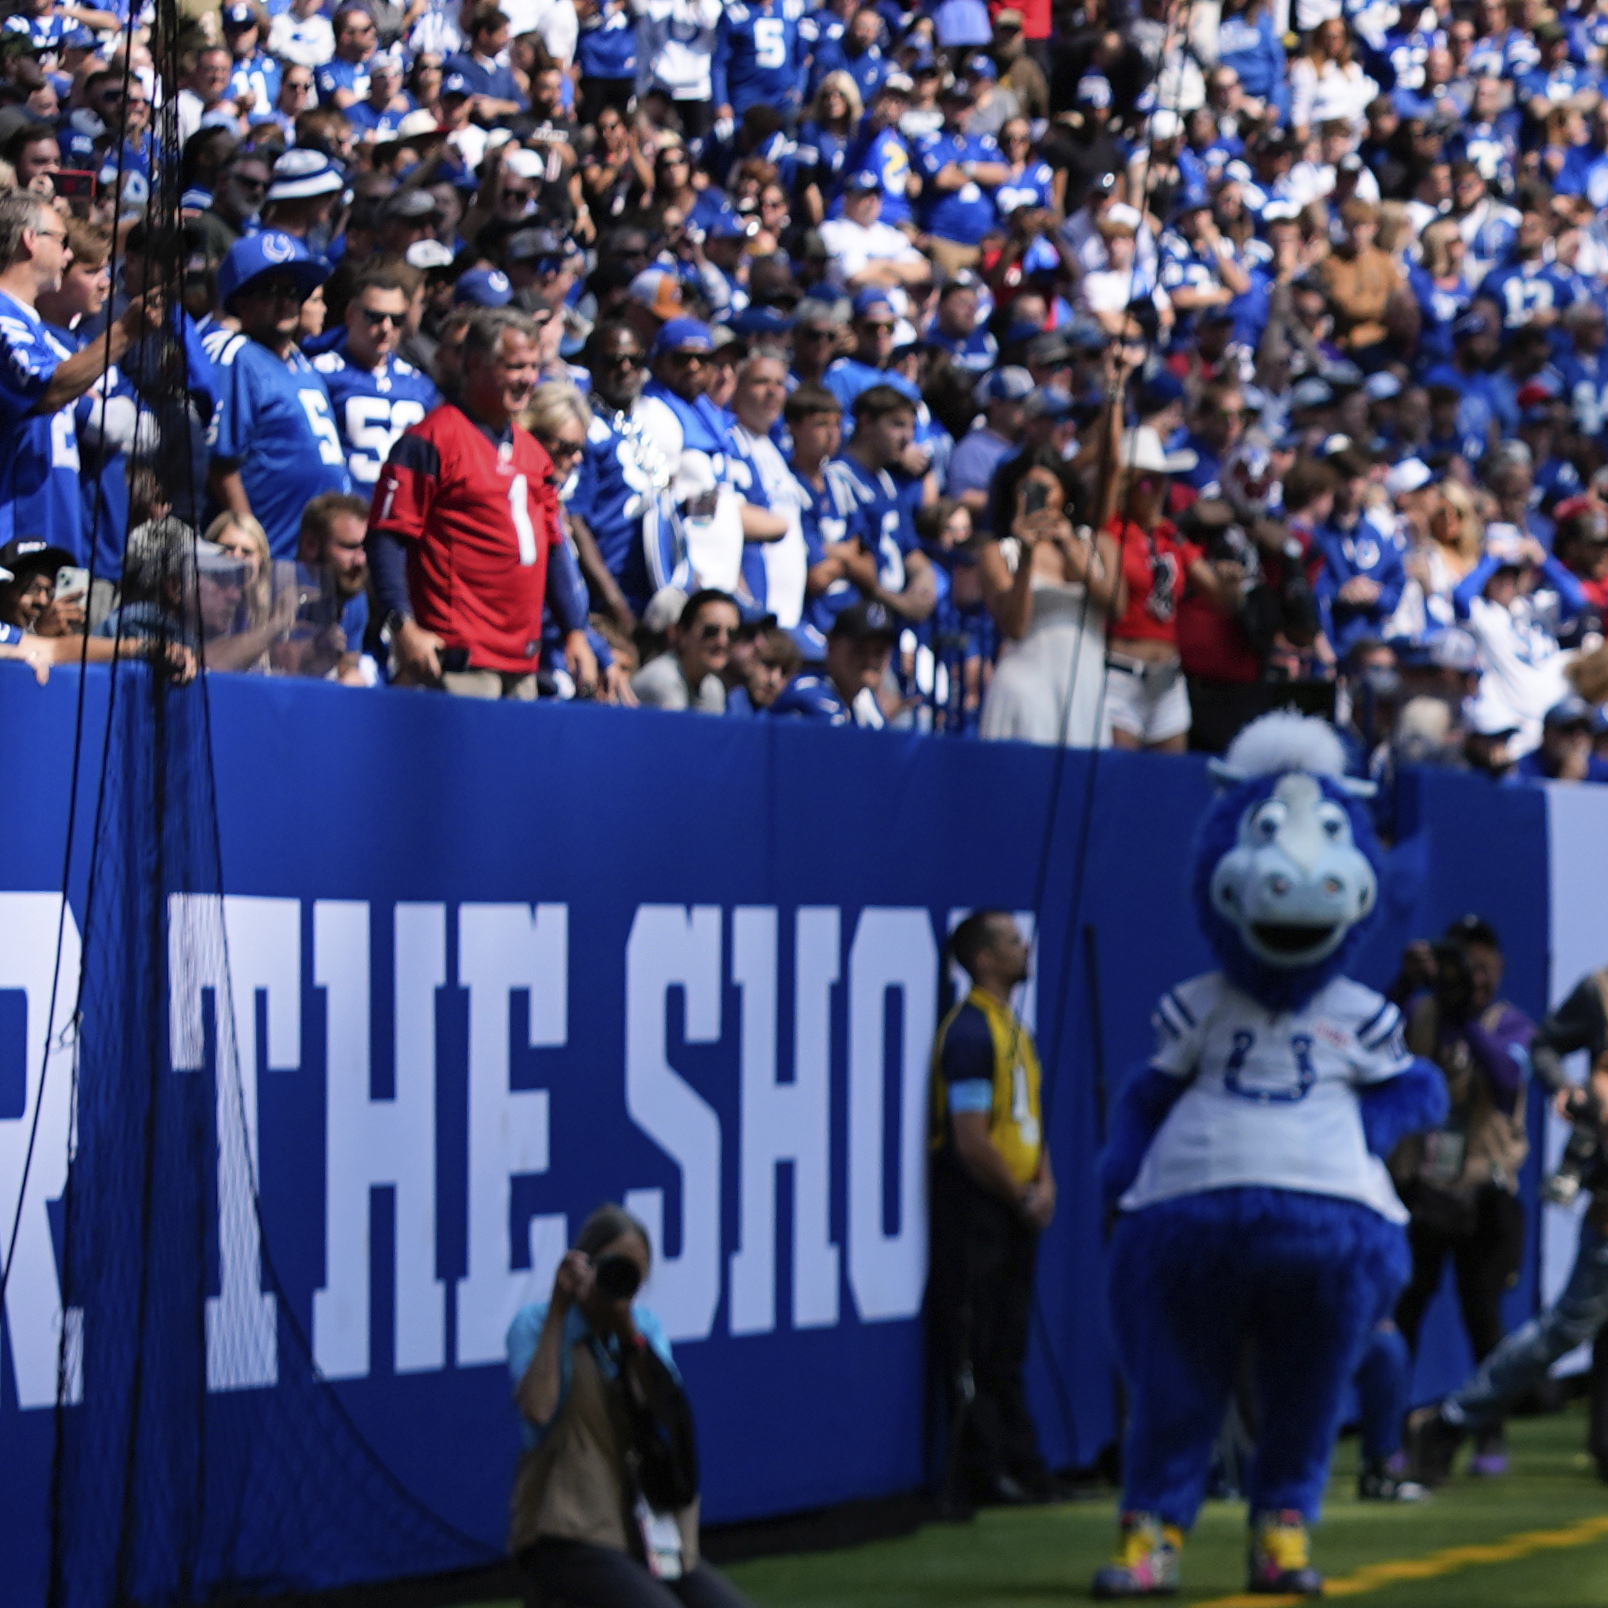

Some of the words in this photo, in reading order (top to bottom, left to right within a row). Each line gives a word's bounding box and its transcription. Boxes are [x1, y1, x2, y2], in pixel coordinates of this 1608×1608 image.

[756, 17, 785, 69] 5
[301, 388, 344, 465] 5
[505, 472, 538, 567] 1
[168, 892, 569, 1392] THE
[625, 903, 1038, 1342] SHO
